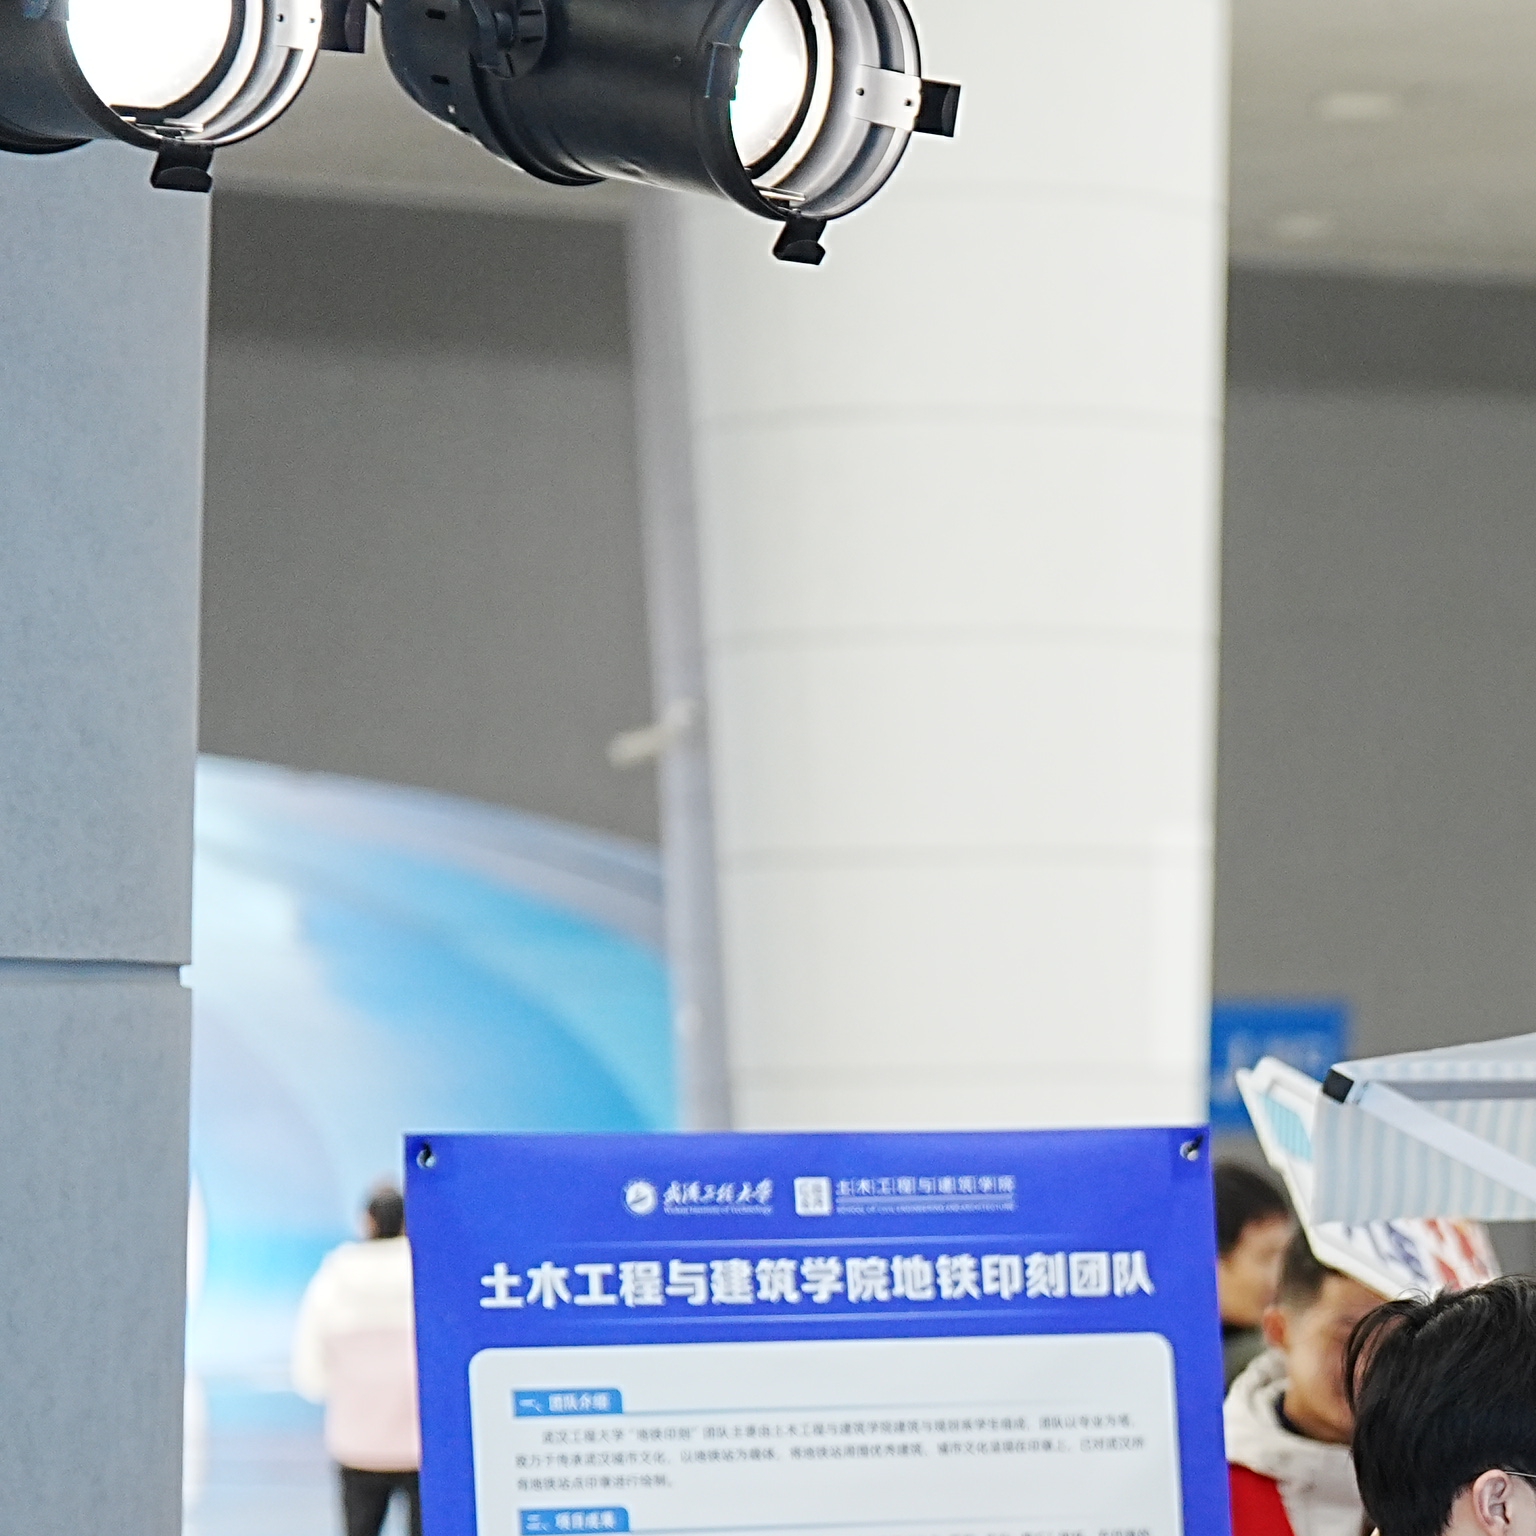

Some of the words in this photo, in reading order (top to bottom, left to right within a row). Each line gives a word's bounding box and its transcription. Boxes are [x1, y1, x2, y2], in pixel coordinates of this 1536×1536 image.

[480, 1251, 1153, 1309] 土木工程与建筑学院地铁印刻团队
